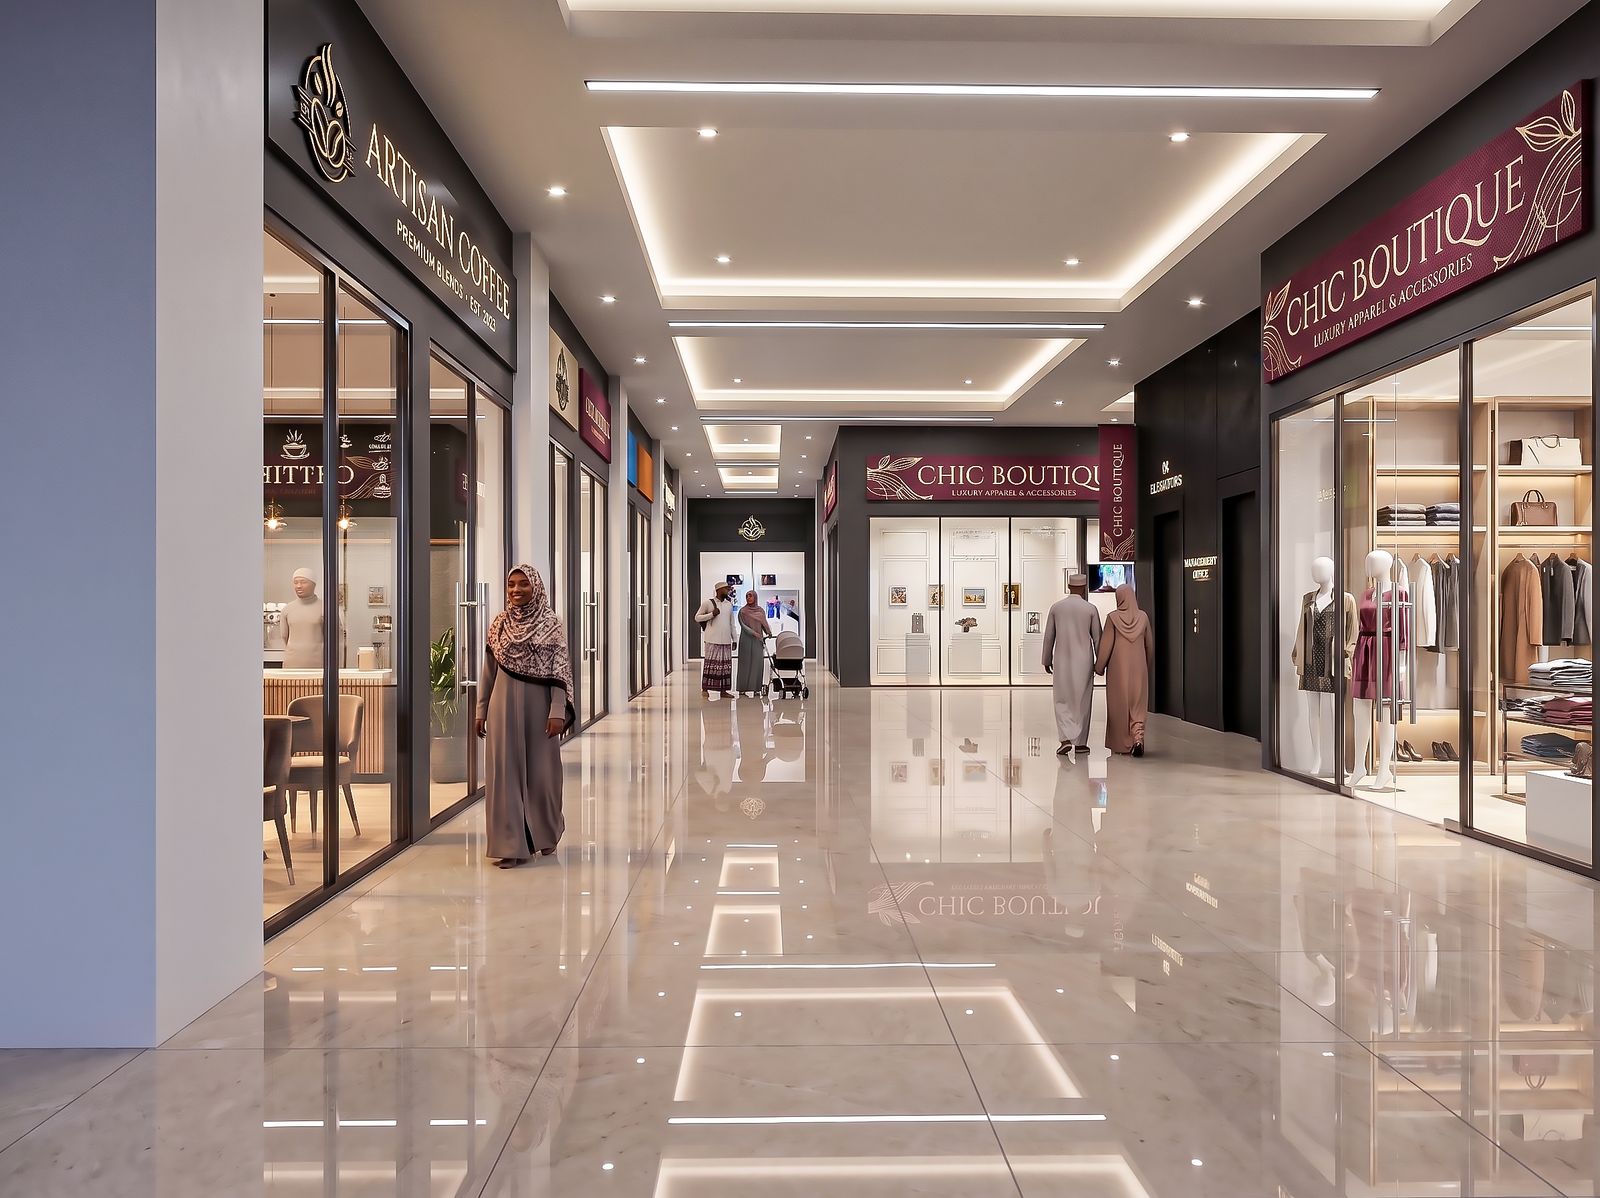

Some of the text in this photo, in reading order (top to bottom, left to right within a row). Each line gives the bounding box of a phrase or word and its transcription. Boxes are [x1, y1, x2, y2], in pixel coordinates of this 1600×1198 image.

[365, 122, 511, 320] ARTISAN COFFEE
[1286, 154, 1526, 337] CHIC BOUTIQUE
[396, 218, 436, 272] PREMIUM
[436, 262, 465, 300] BLENDS
[470, 296, 481, 317] EST
[482, 309, 497, 333] 2023
[1313, 253, 1474, 348] LUXURY APPAREL & ACCESSORIES
[917, 465, 985, 485] CHIC
[951, 489, 1077, 497] LUXURY APPAREL & ACCESSORIES
[1113, 443, 1125, 537] CHIC BOUTIQUE
